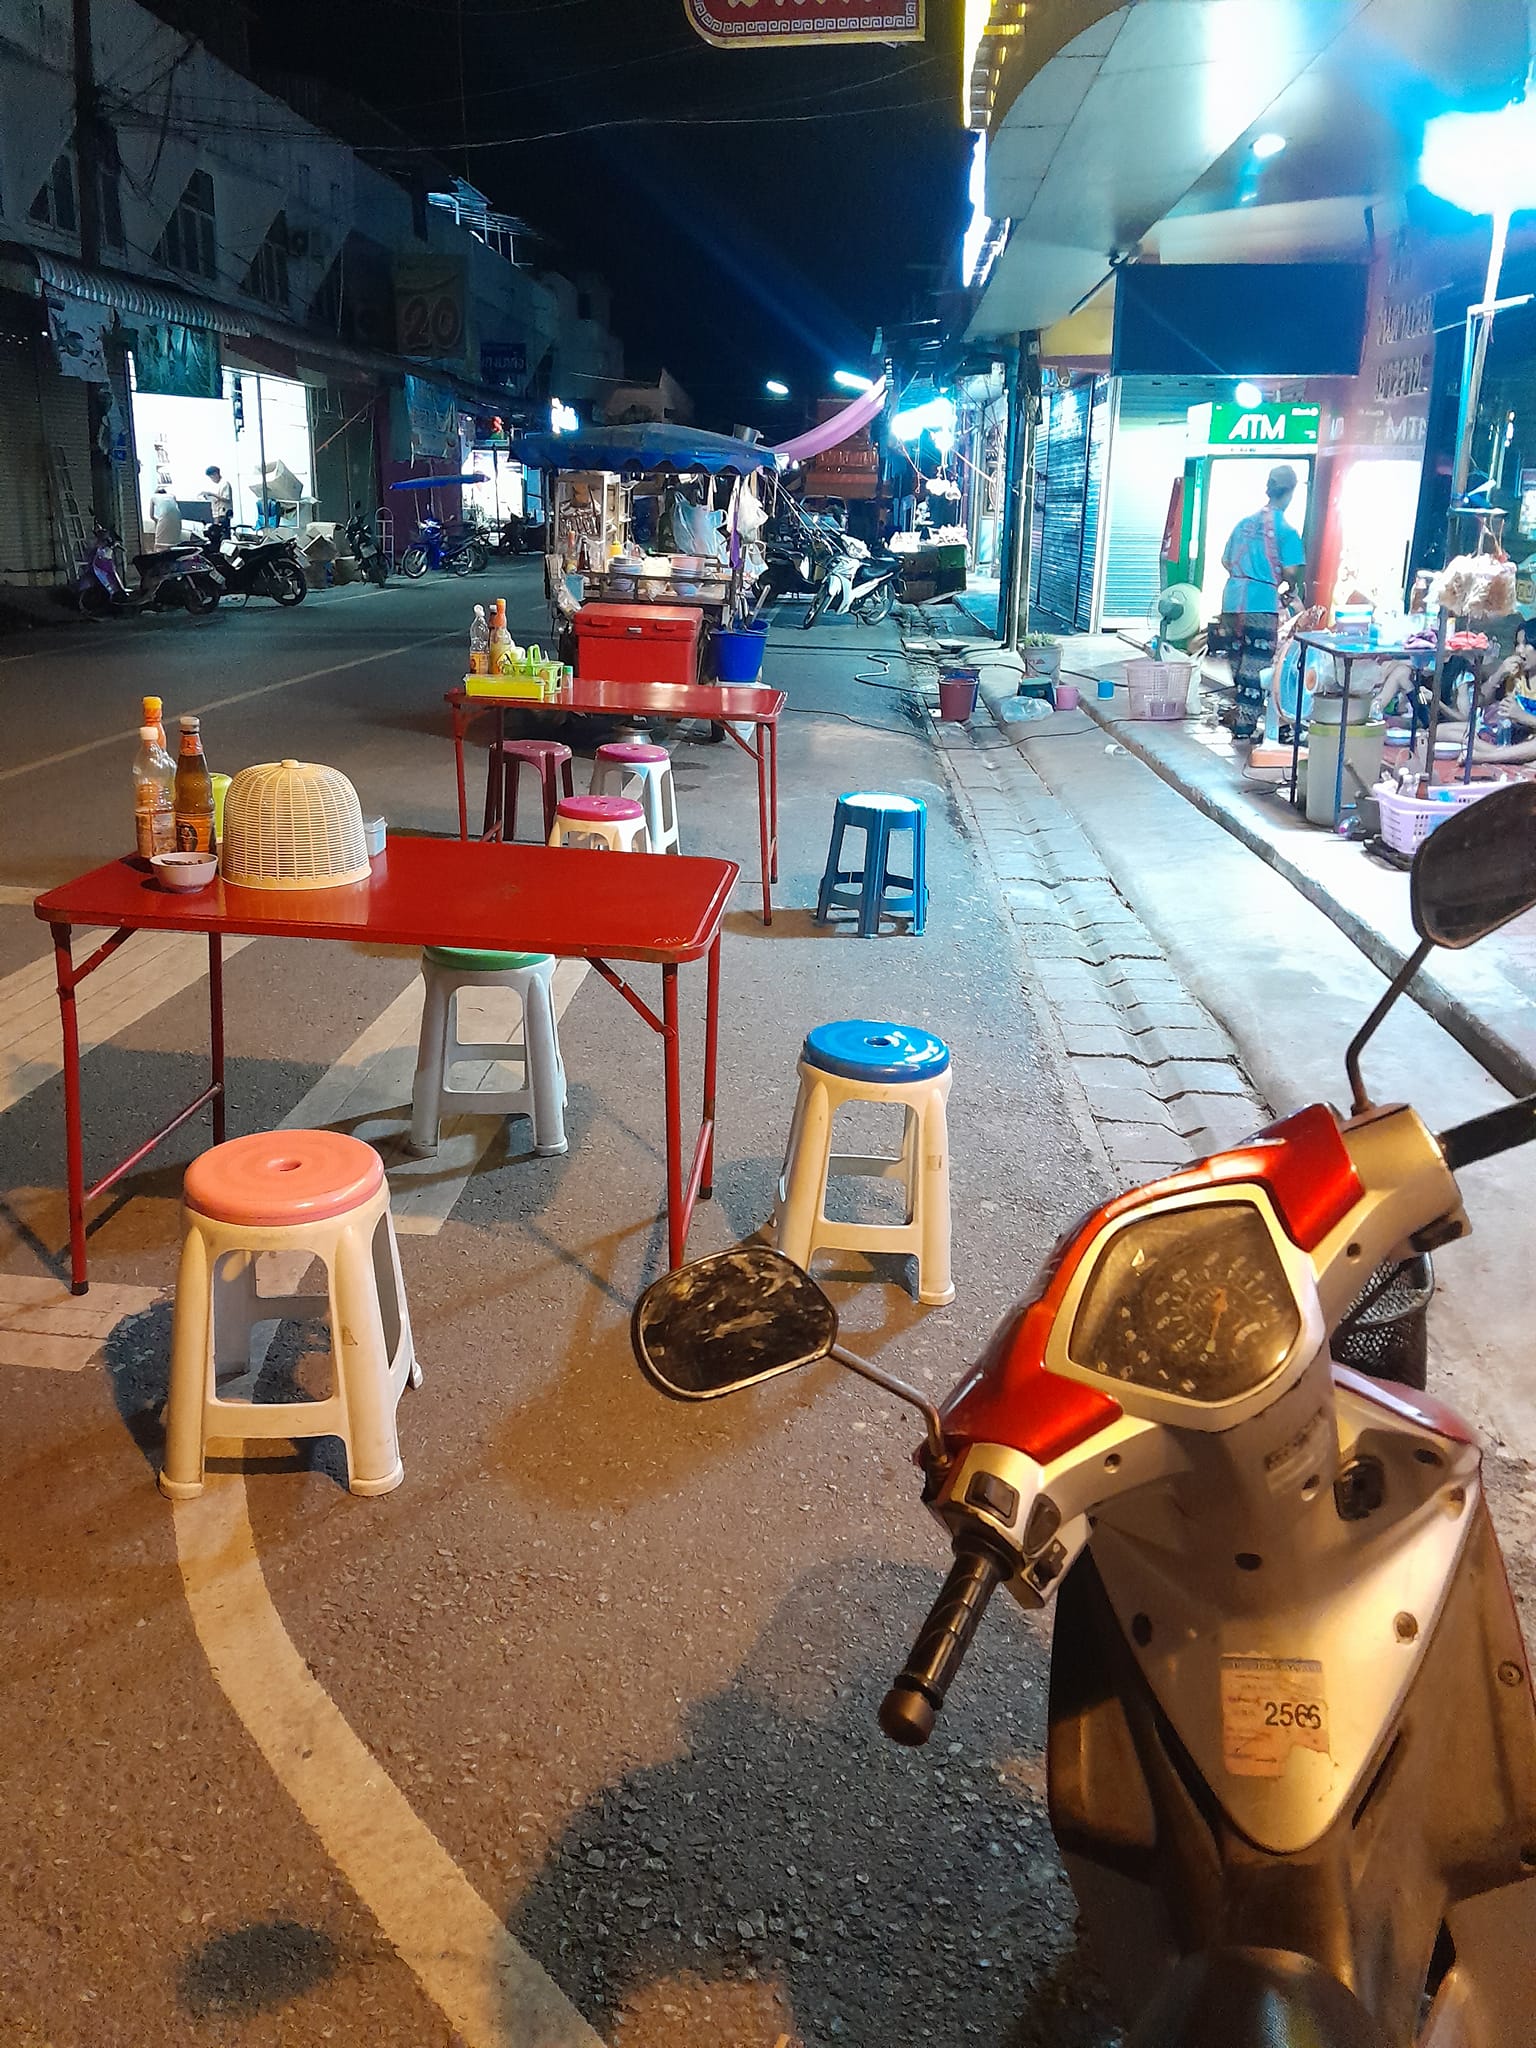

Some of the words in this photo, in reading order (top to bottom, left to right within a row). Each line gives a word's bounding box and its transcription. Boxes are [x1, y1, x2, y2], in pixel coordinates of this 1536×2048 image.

[404, 294, 461, 351] 20
[1228, 413, 1286, 441] ATM
[1264, 1701, 1322, 1730] 2566
